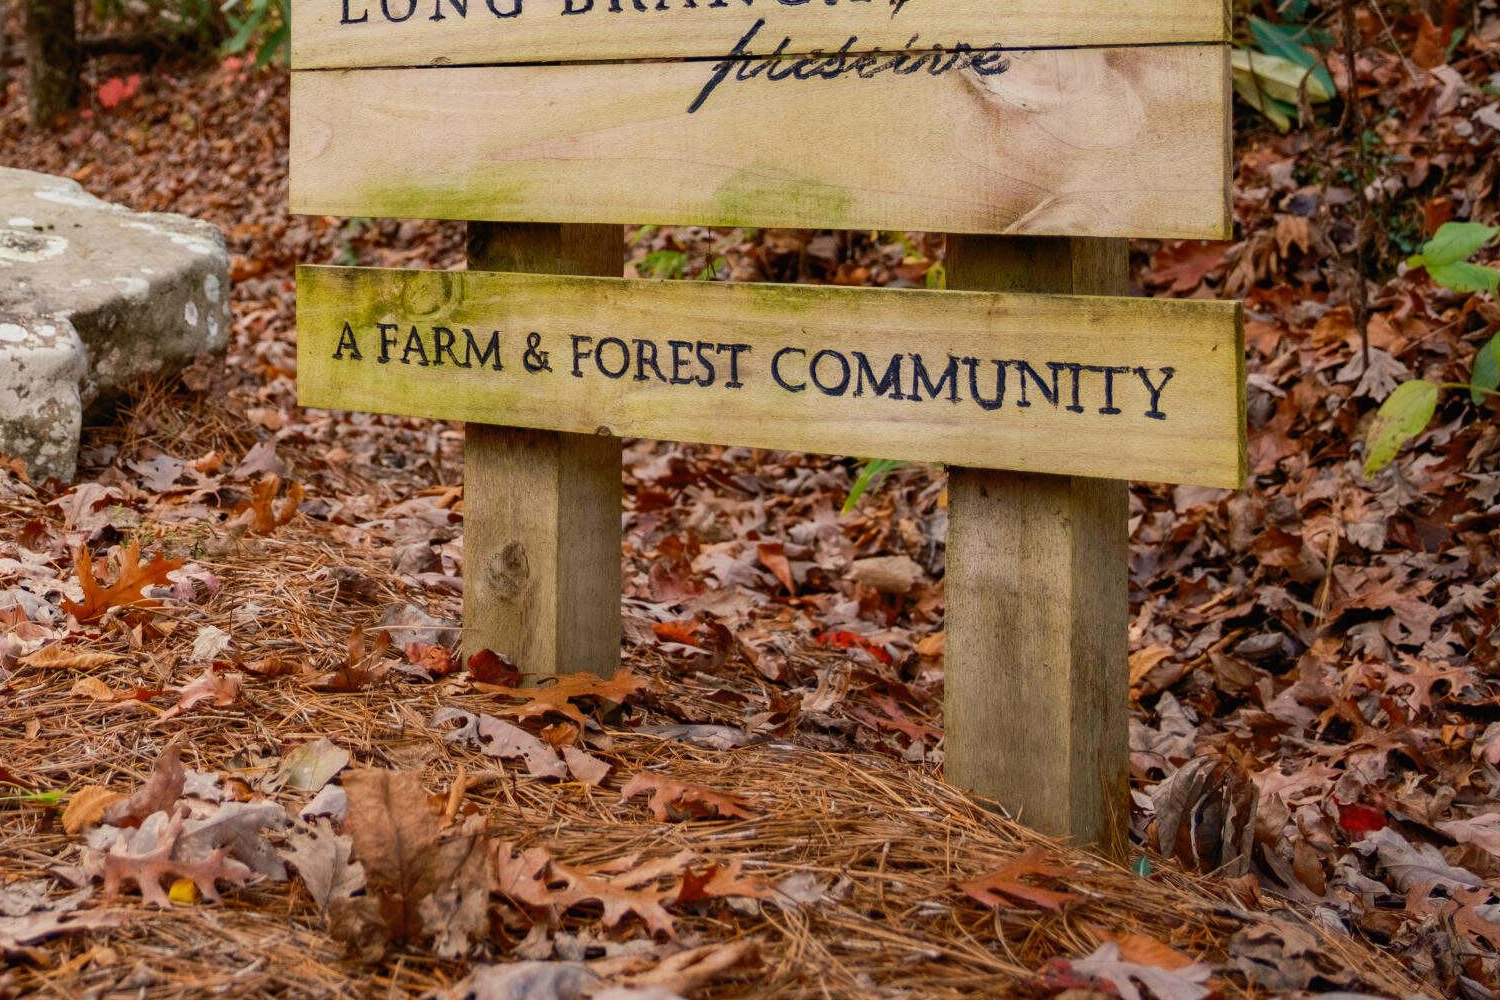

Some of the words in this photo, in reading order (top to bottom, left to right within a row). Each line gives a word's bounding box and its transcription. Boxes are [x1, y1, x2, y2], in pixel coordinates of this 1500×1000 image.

[332, 322, 363, 362] A
[376, 322, 504, 373] FARM
[522, 332, 552, 375] &
[570, 333, 752, 390] FOREST
[771, 345, 1176, 421] COMMUNITY
